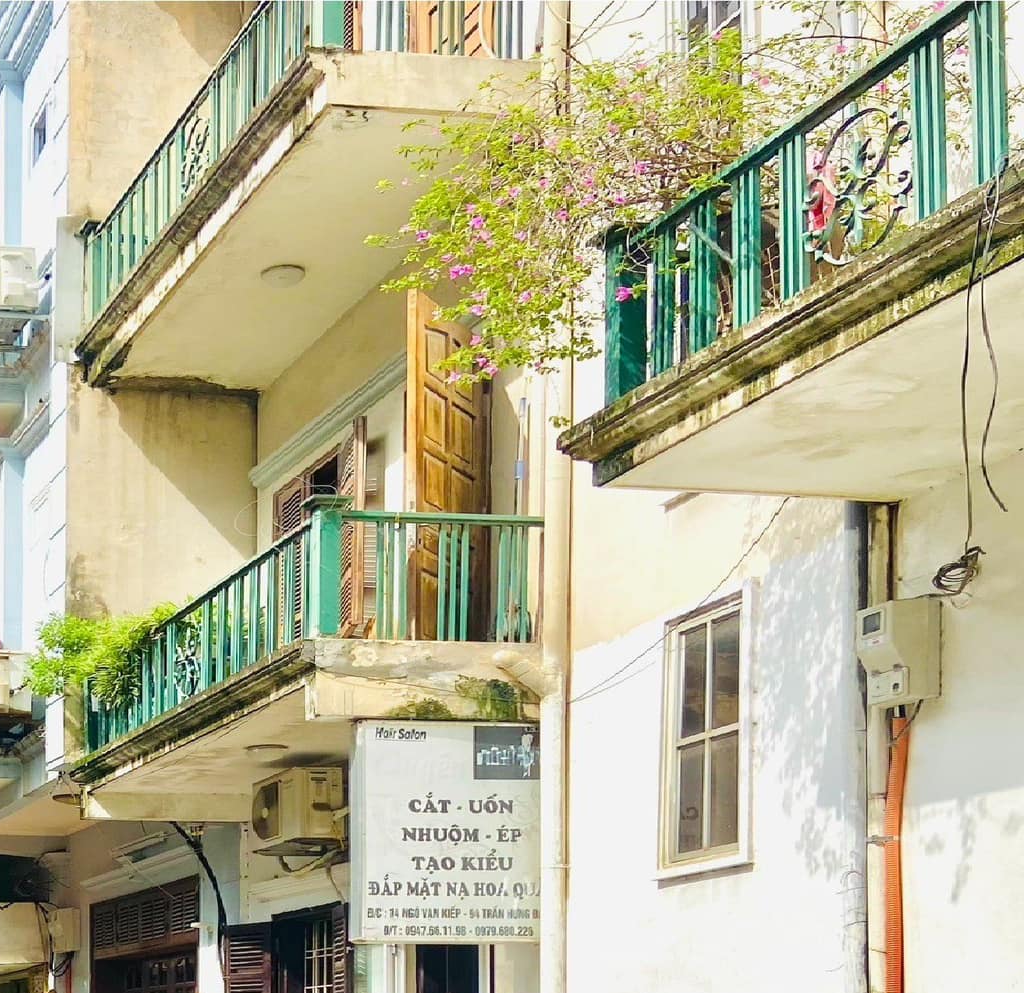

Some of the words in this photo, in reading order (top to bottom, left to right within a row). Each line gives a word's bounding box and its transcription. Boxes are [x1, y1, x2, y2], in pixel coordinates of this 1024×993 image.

[375, 727, 396, 739] Hair
[398, 728, 427, 740] Salon
[408, 792, 451, 814] CẮT
[469, 794, 514, 814] UỐN
[402, 825, 480, 846] NHUỘM
[496, 825, 522, 843] ÉP
[412, 856, 455, 875] TẠO
[461, 849, 514, 871] KIỂU
[368, 874, 403, 897] ĐẮP
[406, 877, 442, 900] MẶT
[446, 881, 470, 900] NẠ
